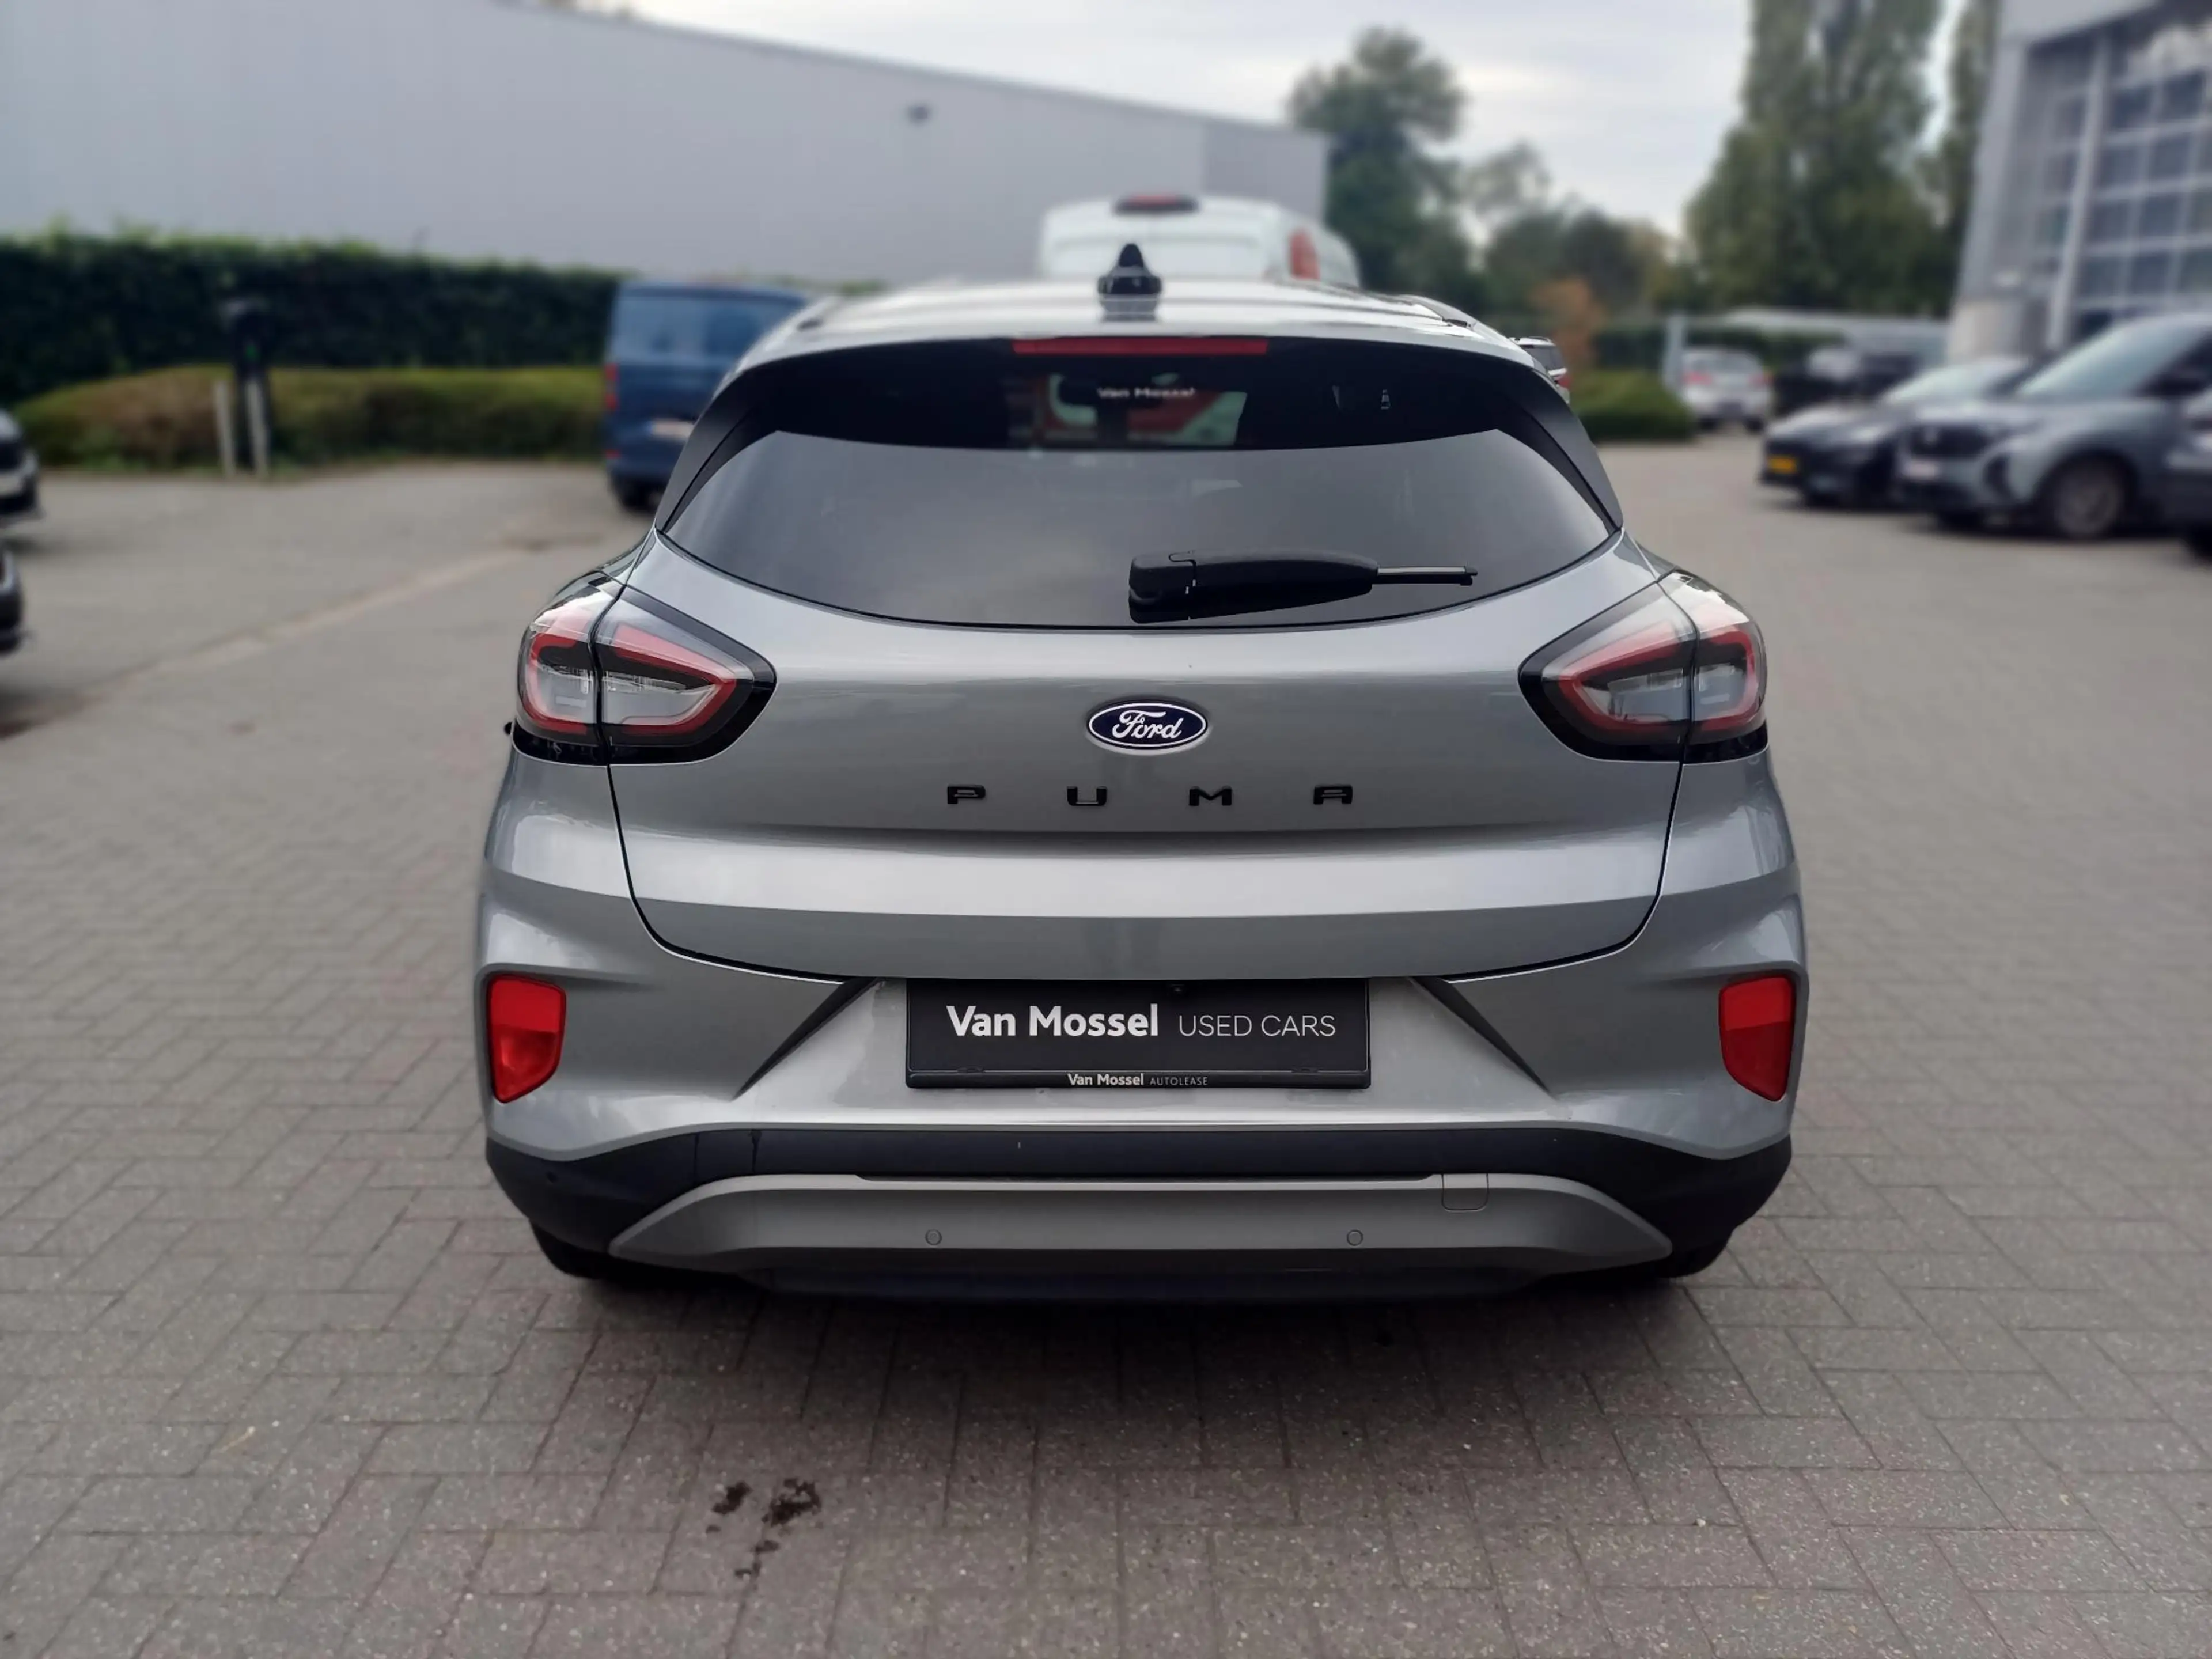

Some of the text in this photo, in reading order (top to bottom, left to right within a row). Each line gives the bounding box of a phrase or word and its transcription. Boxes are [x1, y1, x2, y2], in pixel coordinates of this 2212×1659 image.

[1112, 709, 1184, 738] Ford
[946, 784, 1353, 806] PUMA
[946, 1004, 1336, 1037] Van Mossel USED CARS
[1067, 1073, 1208, 1085] Van Mossel AUTOLEASE
